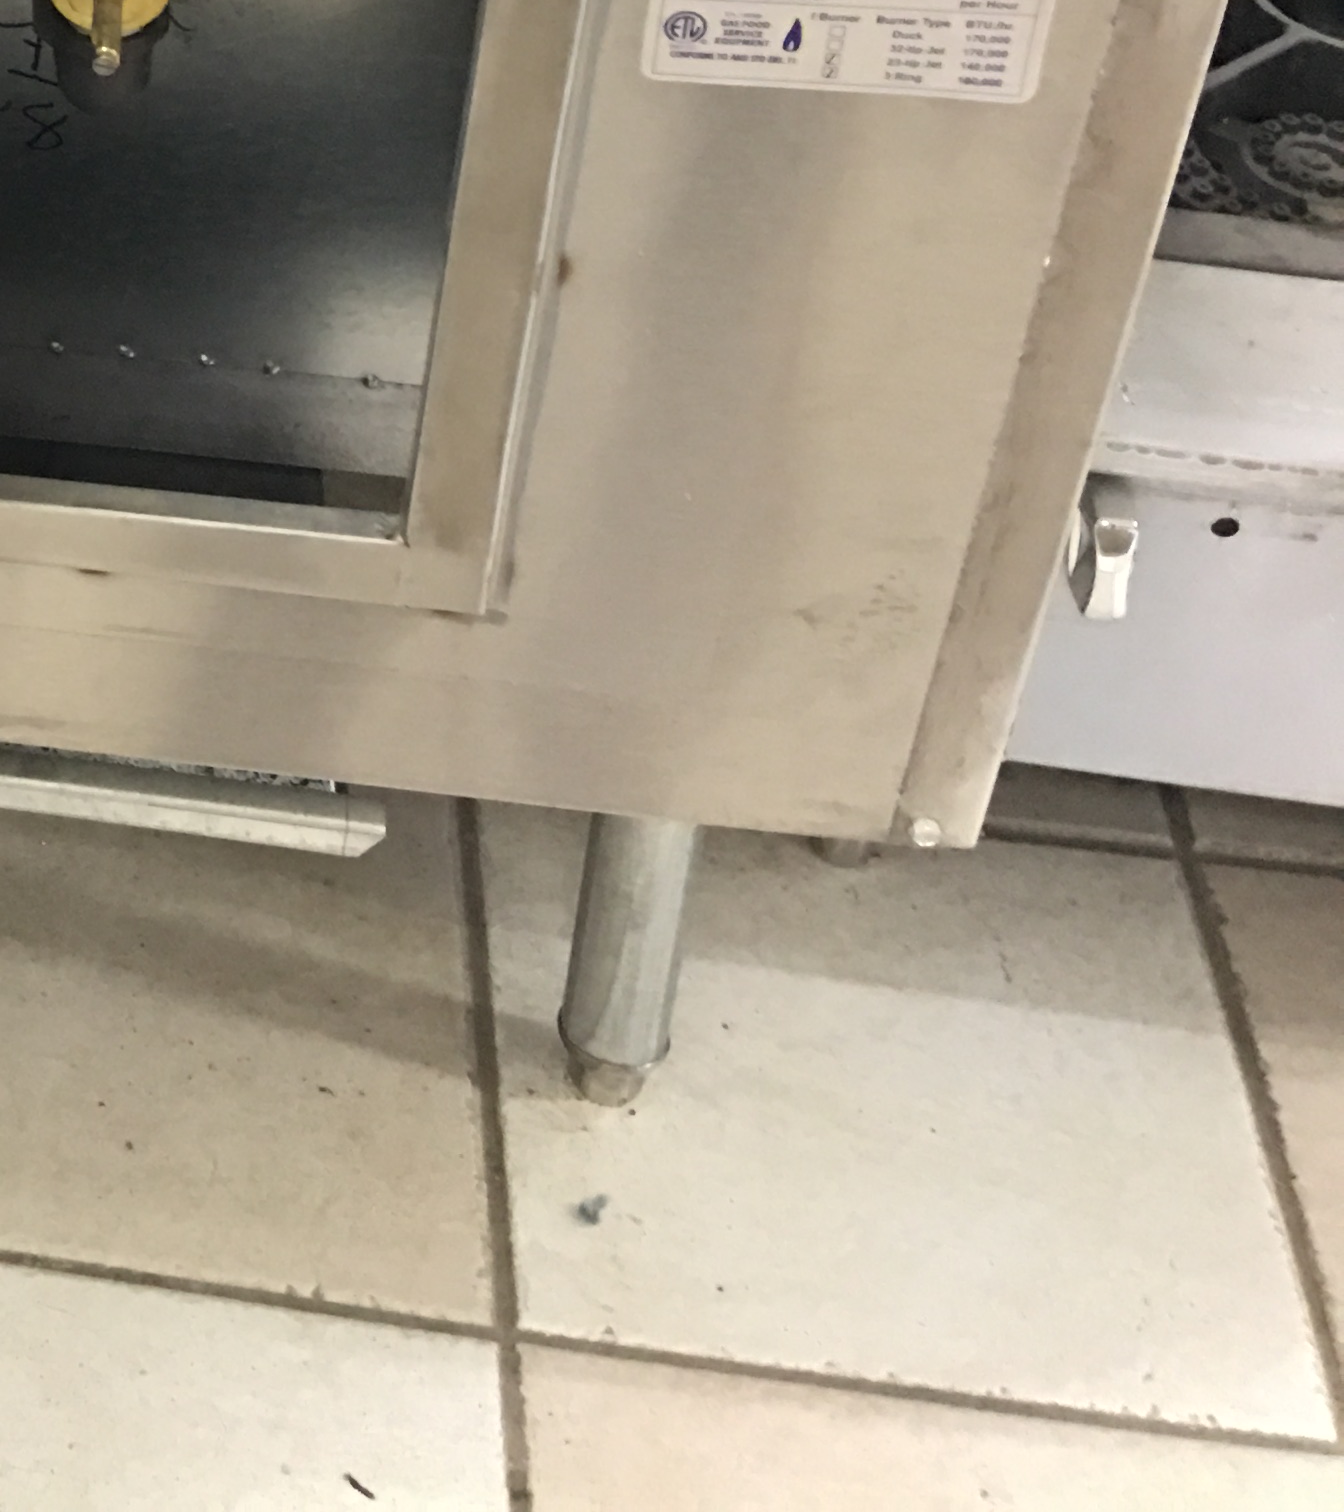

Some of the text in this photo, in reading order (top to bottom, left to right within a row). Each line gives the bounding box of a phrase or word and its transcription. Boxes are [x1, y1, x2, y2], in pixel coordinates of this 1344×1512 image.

[986, 0, 1019, 10] Hour
[876, 15, 950, 29] Burner Type
